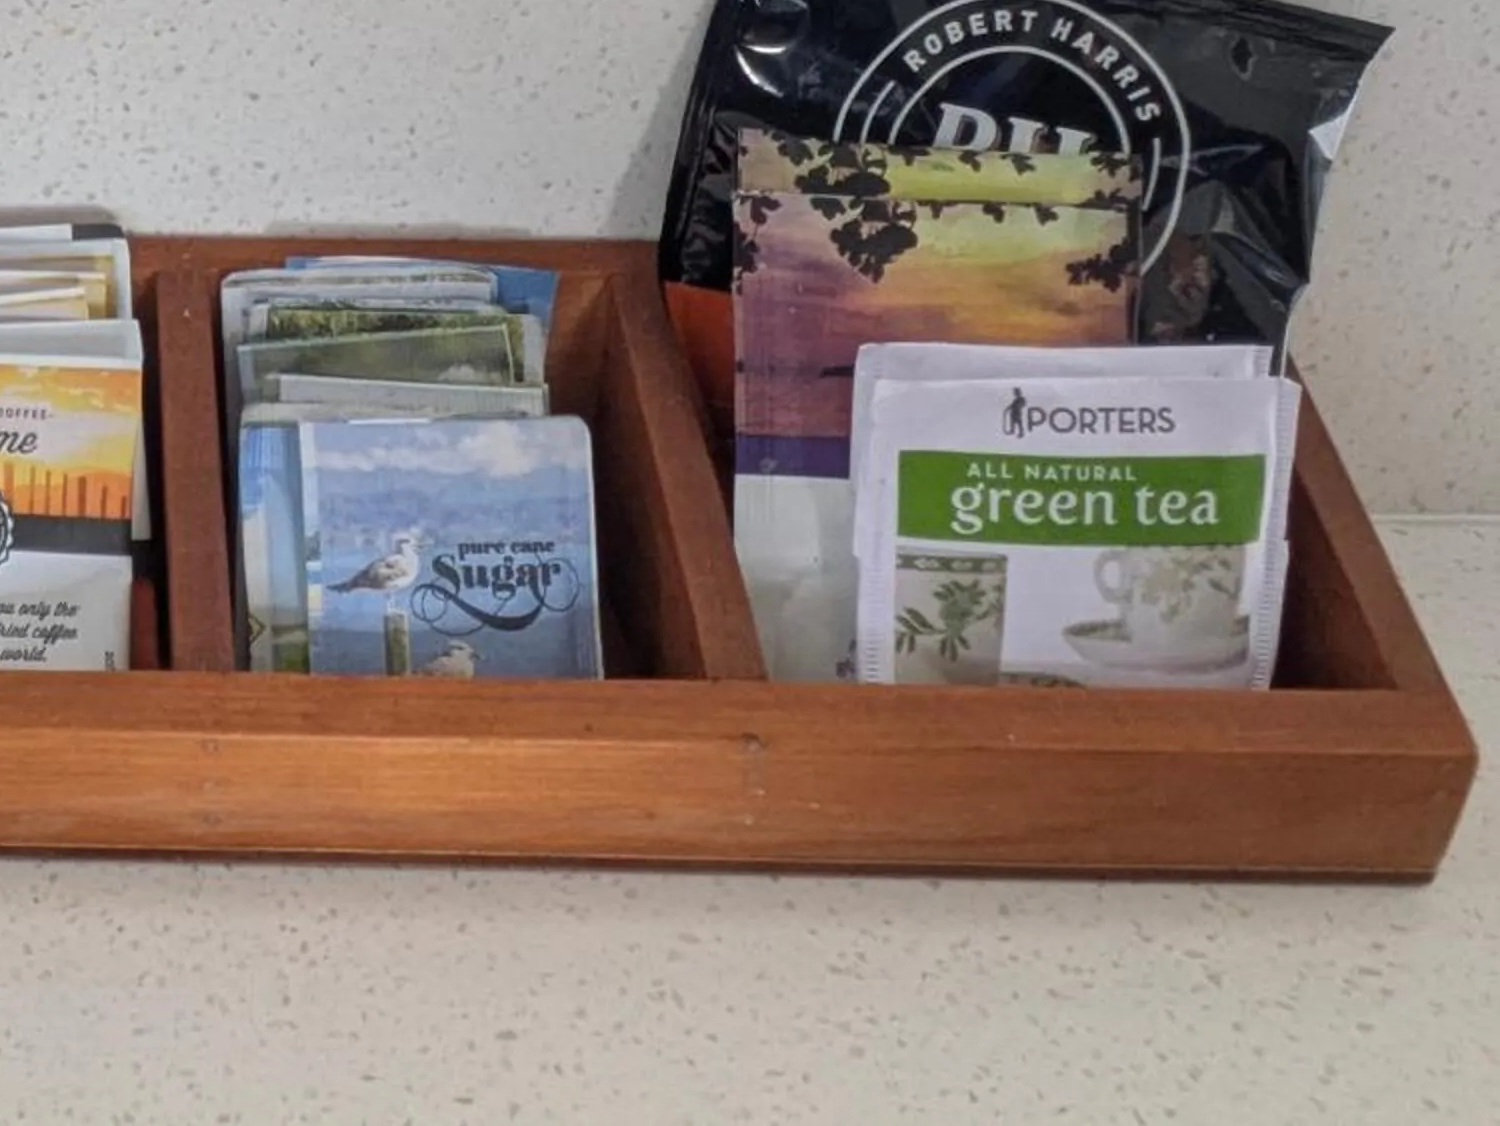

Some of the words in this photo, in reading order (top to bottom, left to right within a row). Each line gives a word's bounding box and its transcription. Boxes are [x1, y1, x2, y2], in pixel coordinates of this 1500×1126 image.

[903, 9, 1038, 73] ROBERT
[1051, 16, 1162, 122] HARRIS
[1026, 406, 1177, 435] PORTERS
[966, 462, 1014, 480] ALL
[1024, 463, 1138, 482] NATURAL
[950, 482, 1119, 536] green
[1134, 485, 1220, 526] tea
[457, 540, 505, 561] pure
[510, 540, 556, 554] cane
